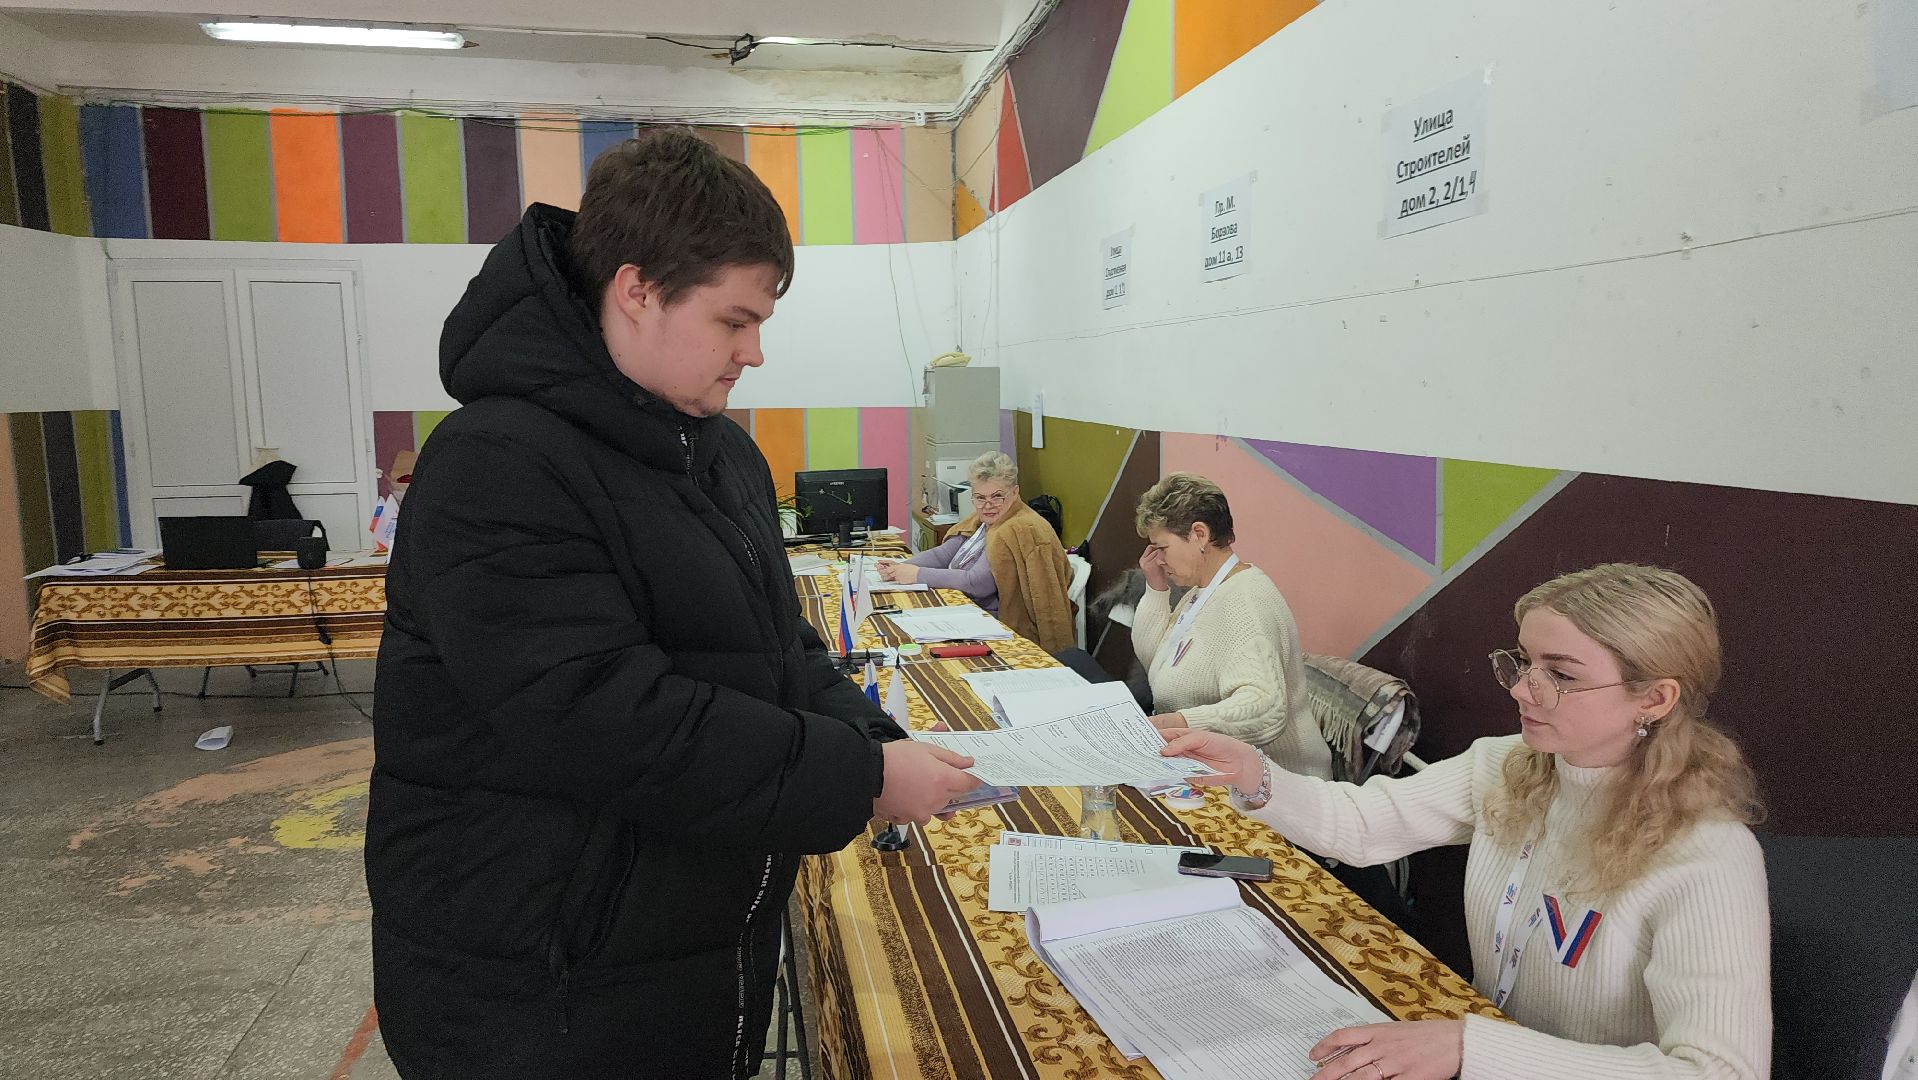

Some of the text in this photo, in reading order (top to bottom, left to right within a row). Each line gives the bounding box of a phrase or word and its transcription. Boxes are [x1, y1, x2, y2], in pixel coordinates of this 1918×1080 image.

[1413, 109, 1454, 139] Улица
[1397, 134, 1471, 179] Строителей
[1401, 194, 1426, 217] дом
[1428, 186, 1440, 206] 2,
